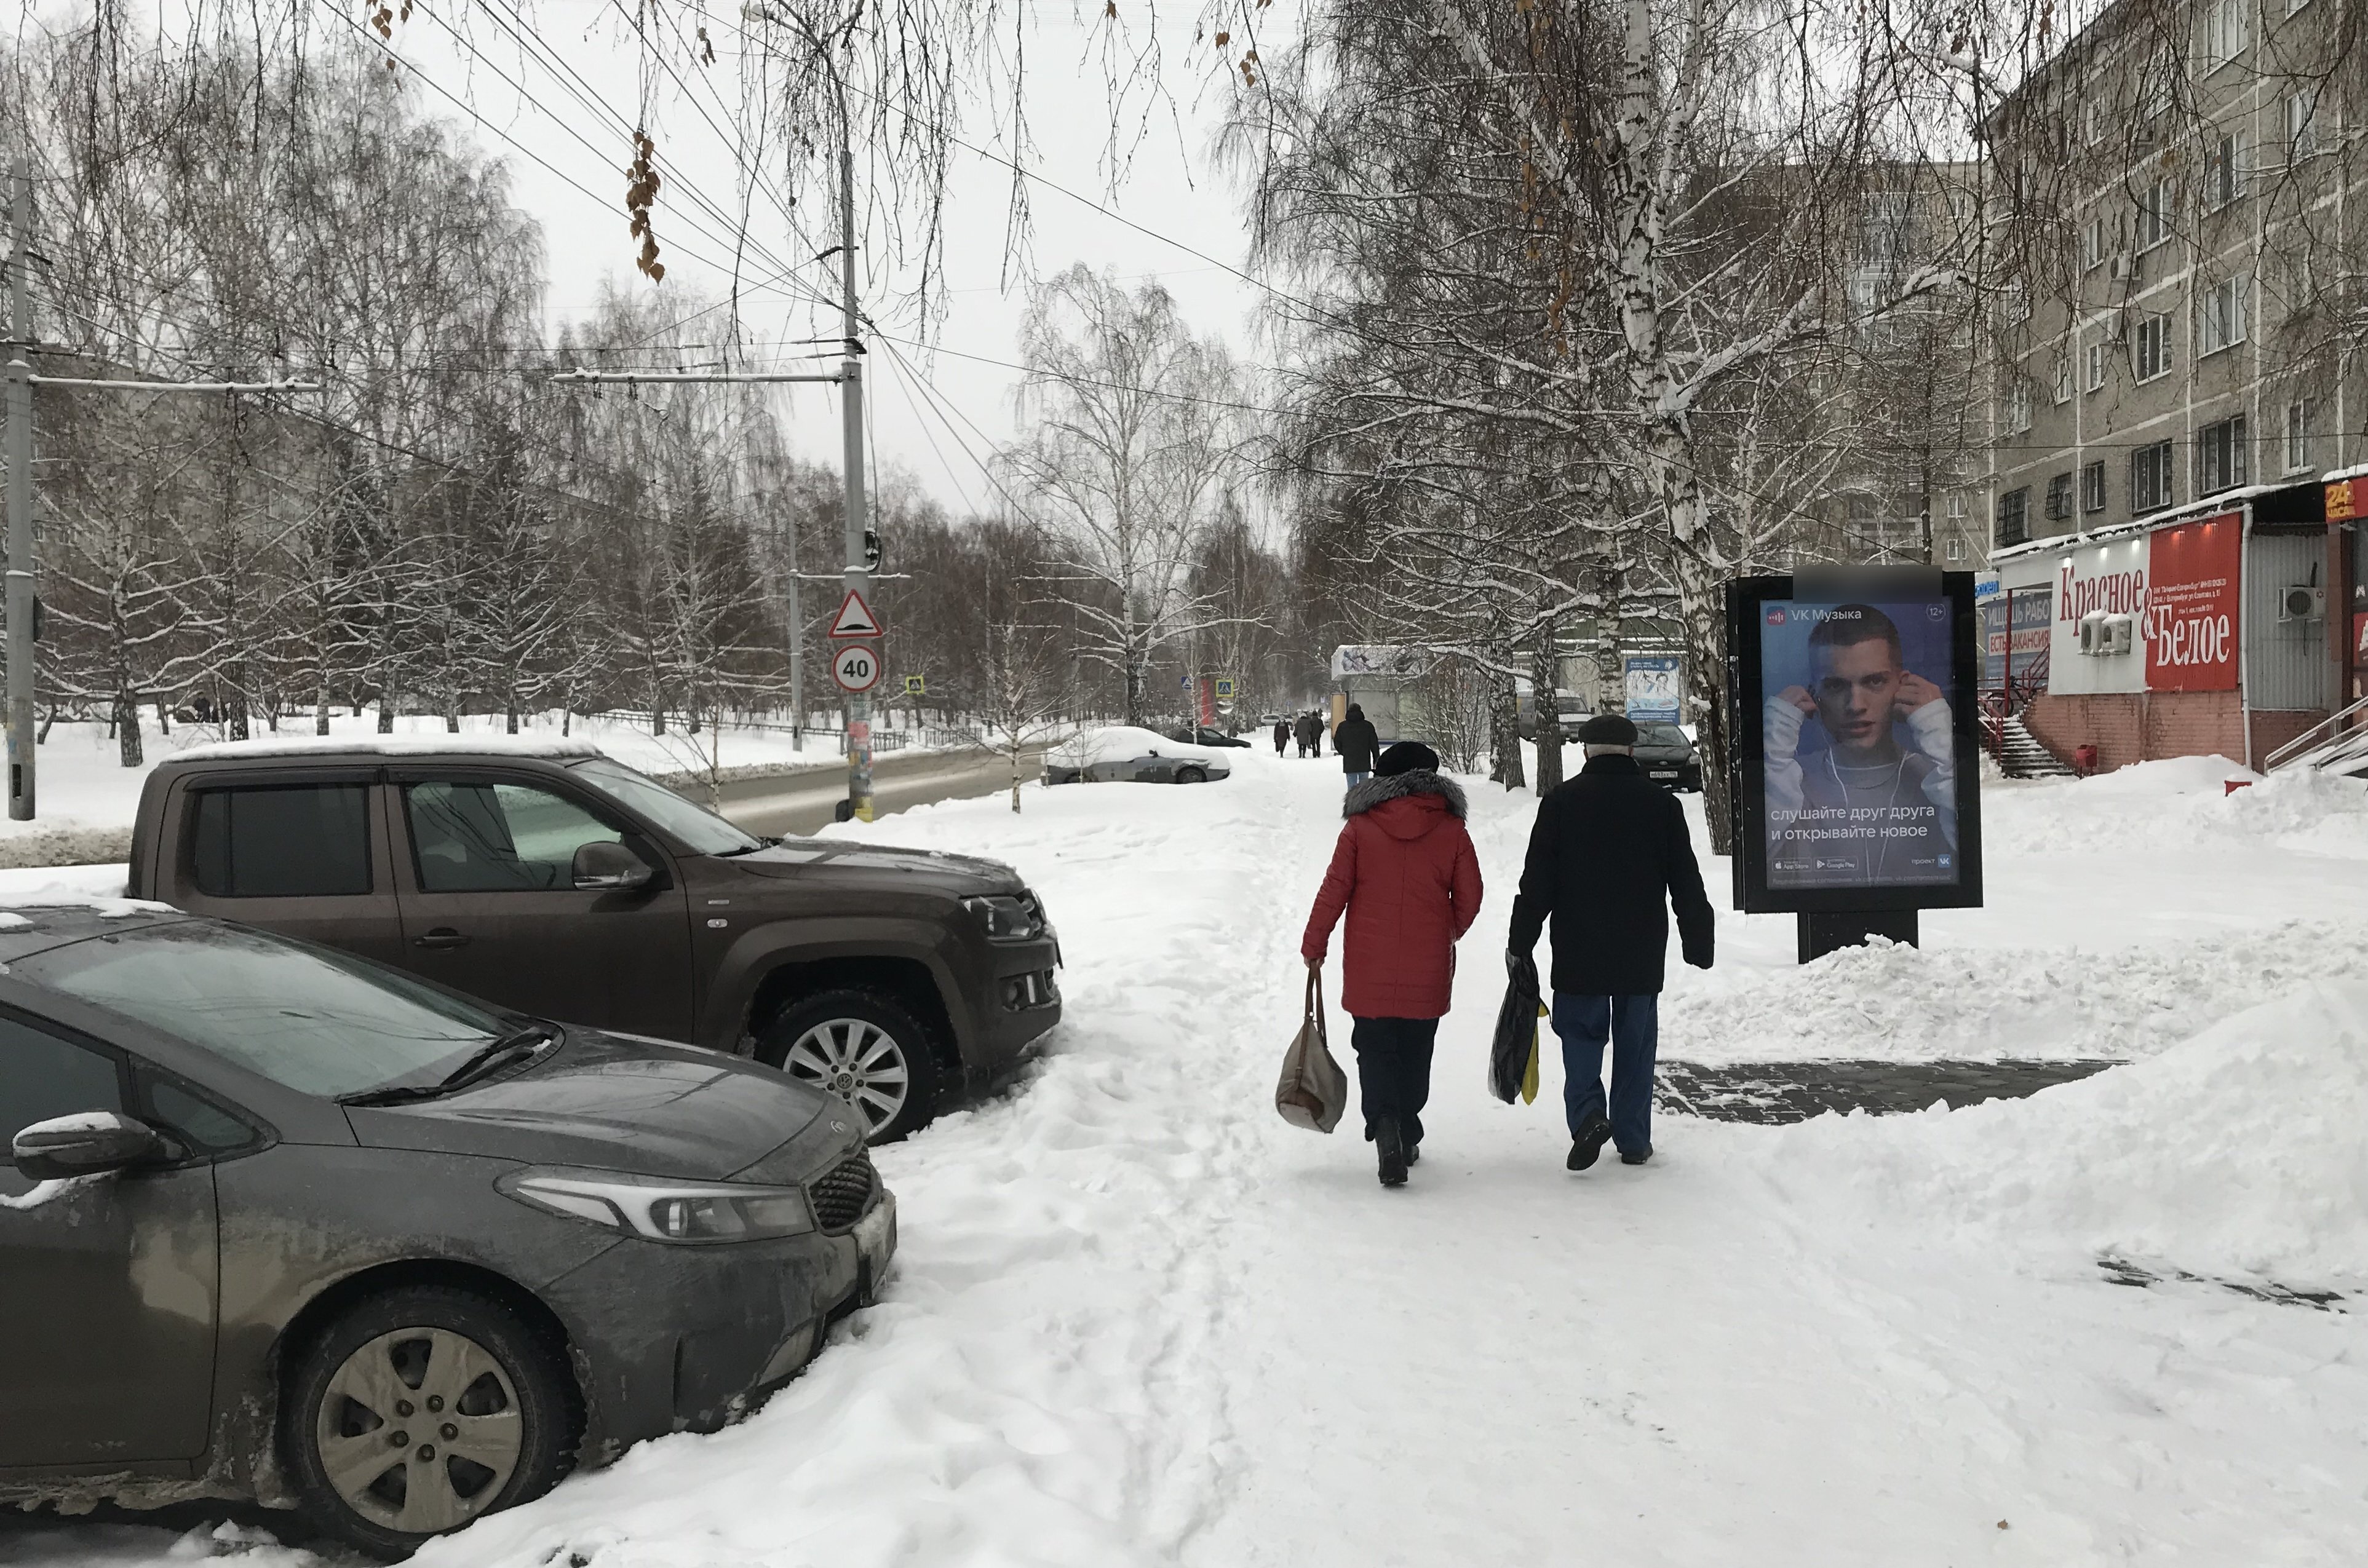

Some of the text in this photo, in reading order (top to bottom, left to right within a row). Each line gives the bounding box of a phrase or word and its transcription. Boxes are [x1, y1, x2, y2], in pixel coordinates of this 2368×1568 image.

[2327, 484, 2348, 508] 24
[1929, 608, 1944, 616] 12+
[2060, 565, 2158, 641] Красное &
[1791, 609, 1862, 623] VK Музыка
[1989, 599, 2051, 628] ИЩШЬ РАБО
[2156, 604, 2230, 667] Белое
[843, 659, 868, 678] 40
[1771, 806, 1935, 823] слушайте друг друга
[1771, 825, 1928, 842] и открывайте новое
